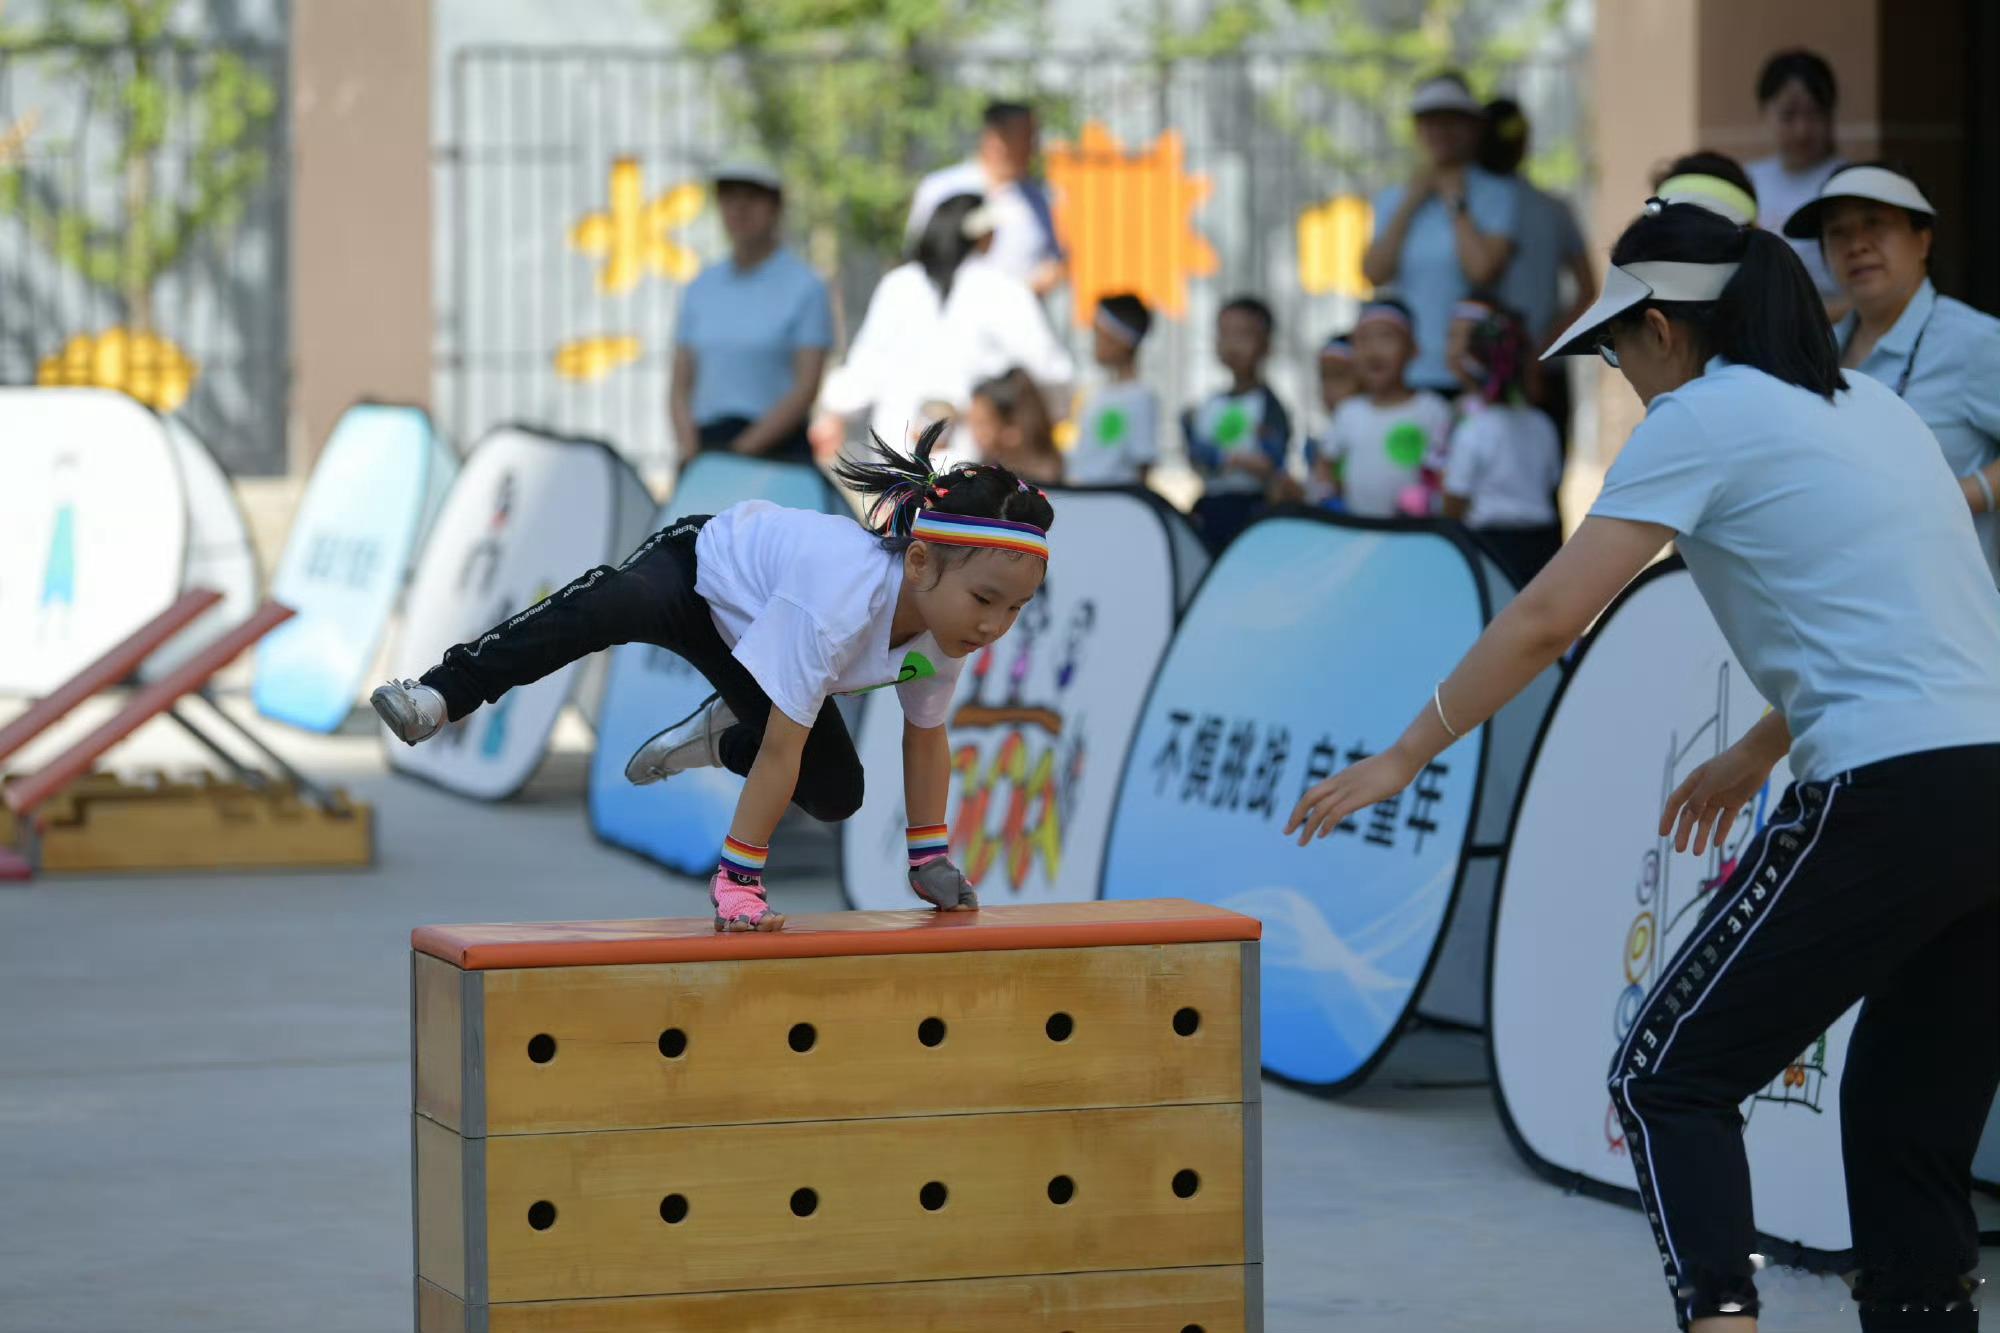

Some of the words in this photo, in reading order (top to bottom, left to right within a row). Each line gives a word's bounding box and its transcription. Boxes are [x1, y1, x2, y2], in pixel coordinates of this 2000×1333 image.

[508, 599, 551, 629] BURBERRY
[1725, 864, 1777, 935] ERKE
[1663, 943, 1719, 1014] ERKE
